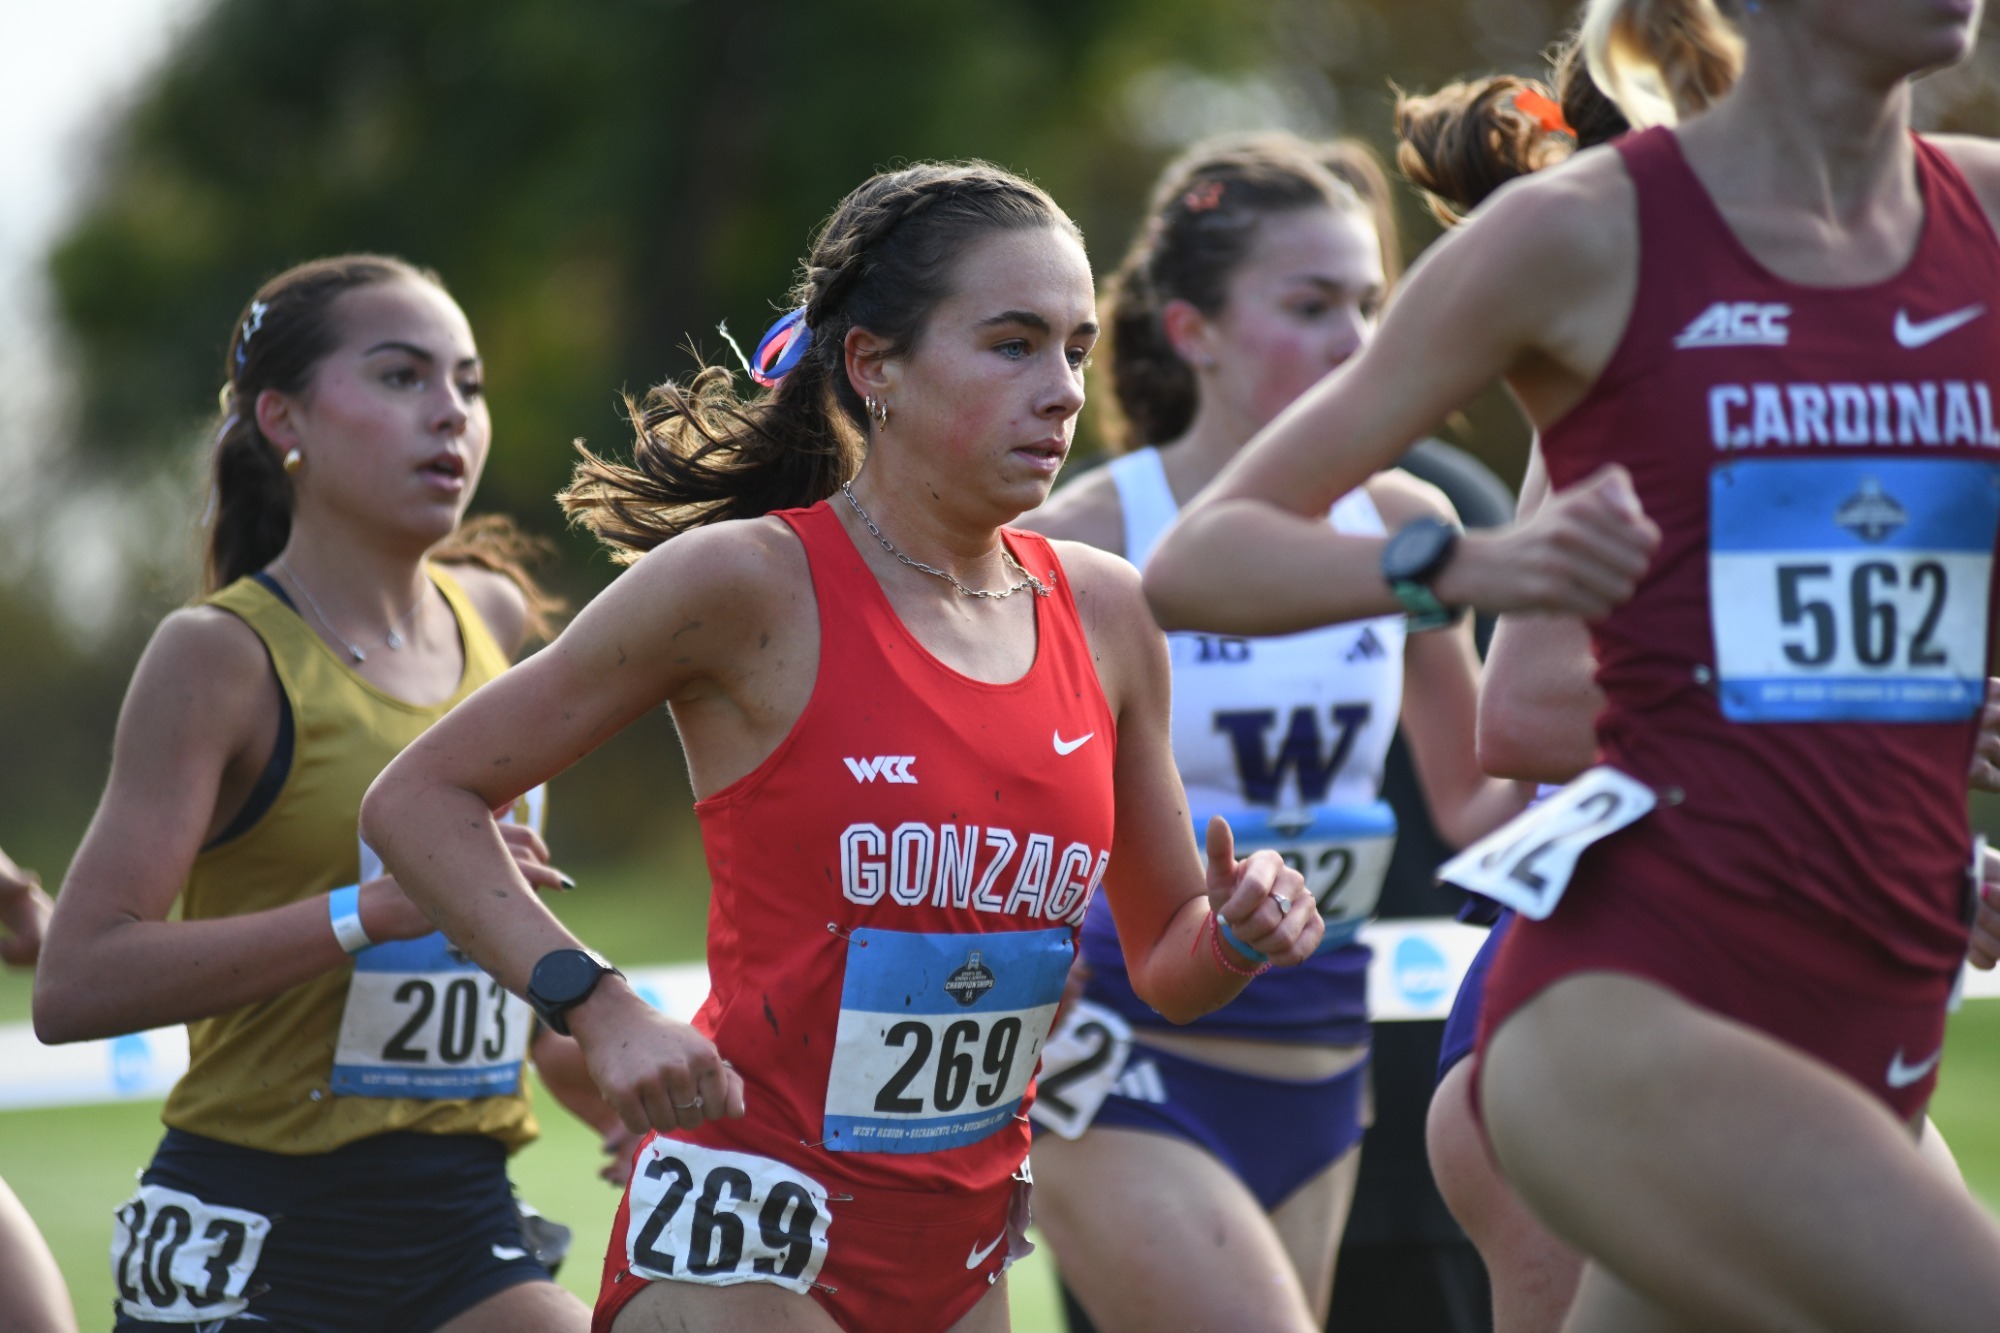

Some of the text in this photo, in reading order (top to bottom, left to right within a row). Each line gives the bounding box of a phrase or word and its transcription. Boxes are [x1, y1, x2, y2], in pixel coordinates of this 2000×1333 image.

[1673, 302, 1792, 348] ACC
[1708, 380, 2000, 449] CARDINAL
[1775, 560, 1948, 669] 562
[843, 756, 918, 784] WCC
[1213, 702, 1372, 805] W
[382, 978, 507, 1064] 203
[874, 1016, 1022, 1114] 269
[853, 1125, 875, 1137] WEST
[877, 1127, 905, 1139] REGION
[633, 1156, 817, 1279] 269
